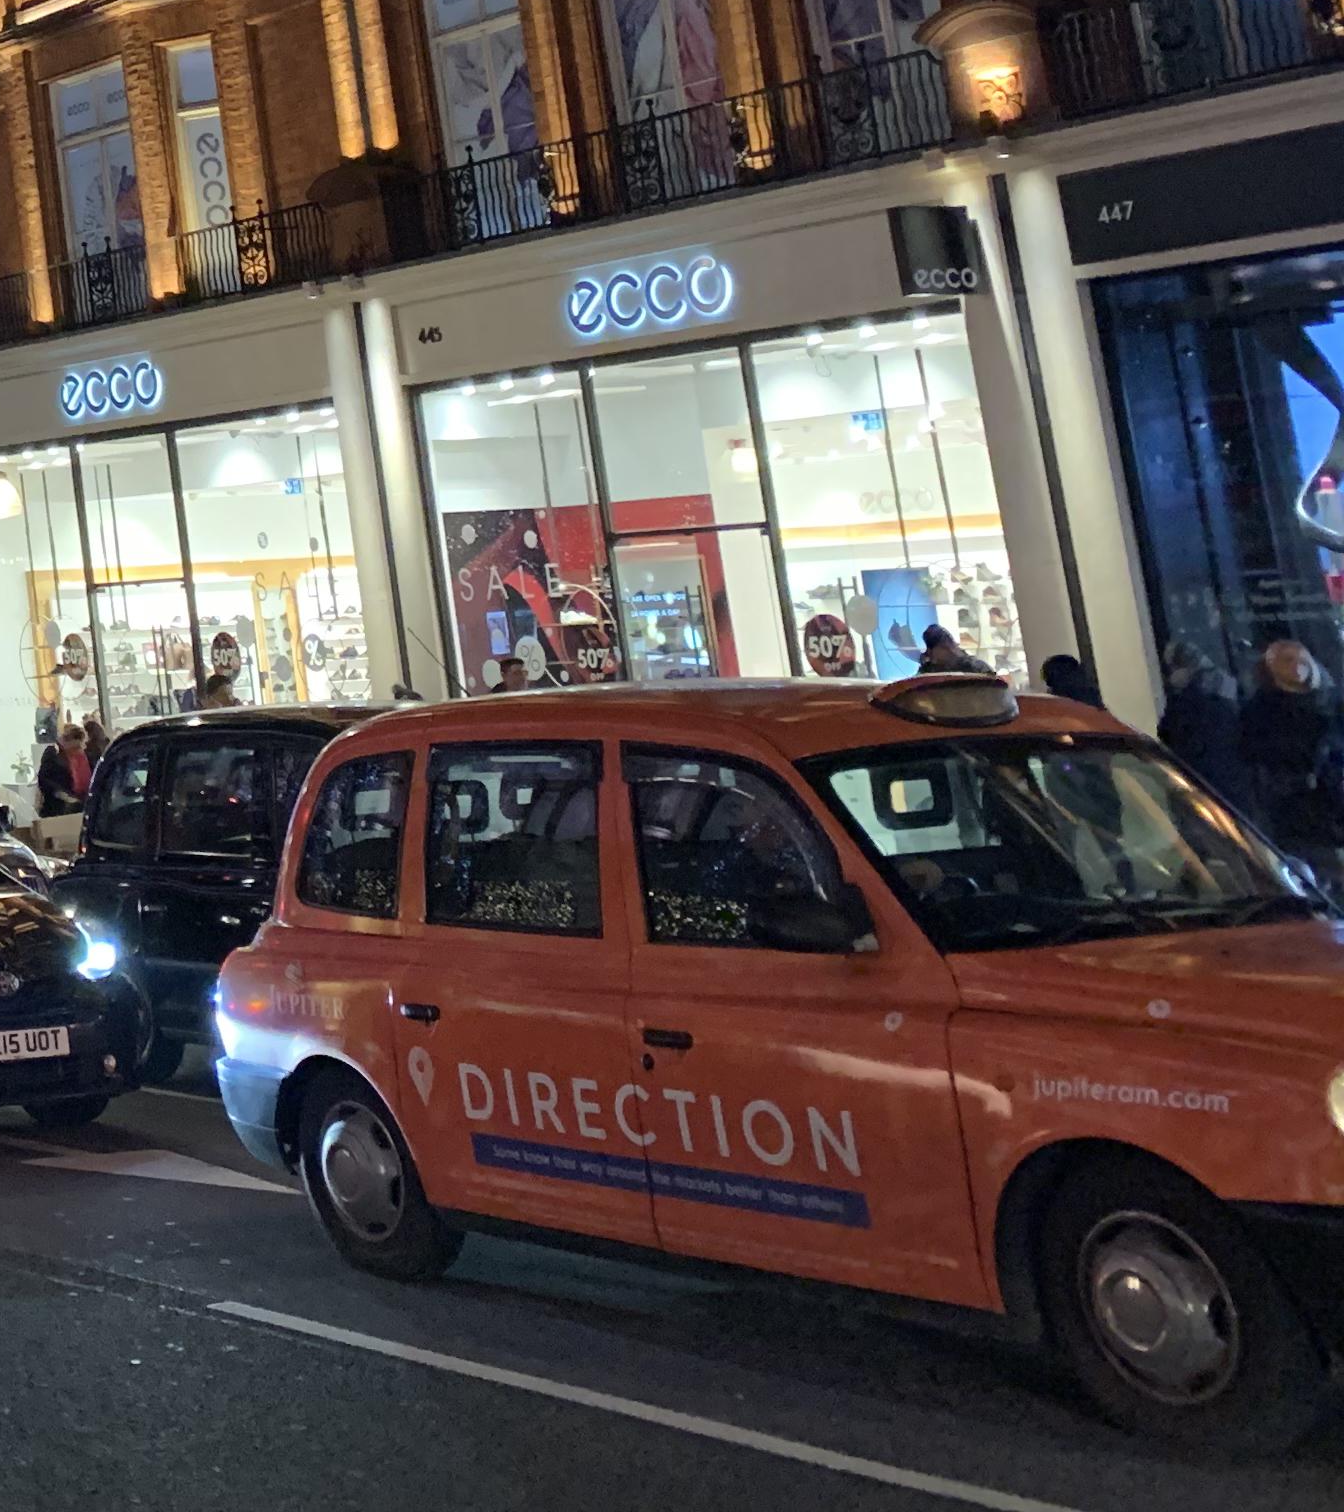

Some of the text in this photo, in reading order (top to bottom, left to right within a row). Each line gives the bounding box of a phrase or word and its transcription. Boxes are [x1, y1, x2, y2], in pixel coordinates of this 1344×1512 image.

[1098, 199, 1134, 224] 447
[567, 254, 733, 335] ecco
[913, 267, 979, 290] ecco
[61, 359, 162, 419] ecco
[458, 562, 565, 603] SALE
[577, 648, 615, 669] 50%
[807, 634, 853, 659] 50%
[25, 1029, 61, 1053] UOT
[1032, 1072, 1230, 1114] jupiteram.com
[457, 1062, 861, 1178] DIRECTION
